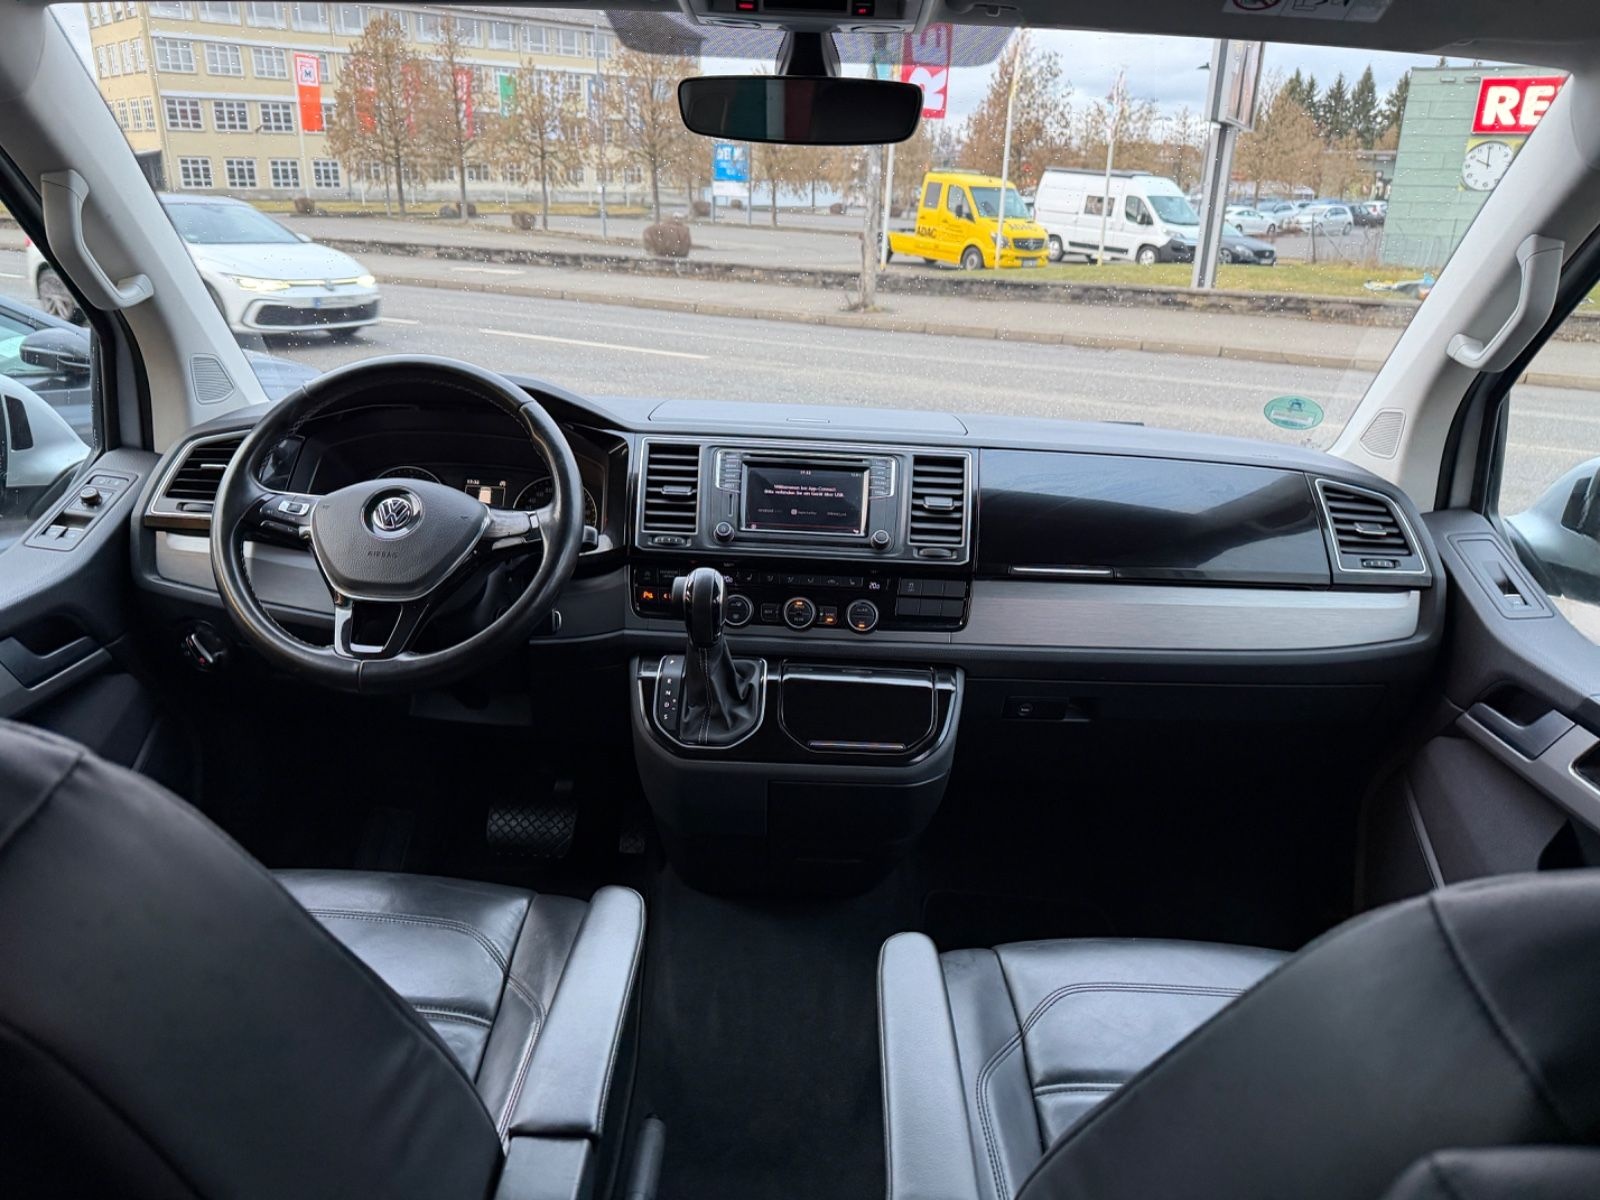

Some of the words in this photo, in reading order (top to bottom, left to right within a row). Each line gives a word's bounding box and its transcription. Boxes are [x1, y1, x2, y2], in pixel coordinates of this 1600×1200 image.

[1482, 85, 1563, 126] RE
[917, 226, 937, 239] ADAC
[368, 551, 398, 559] AIRBAG
